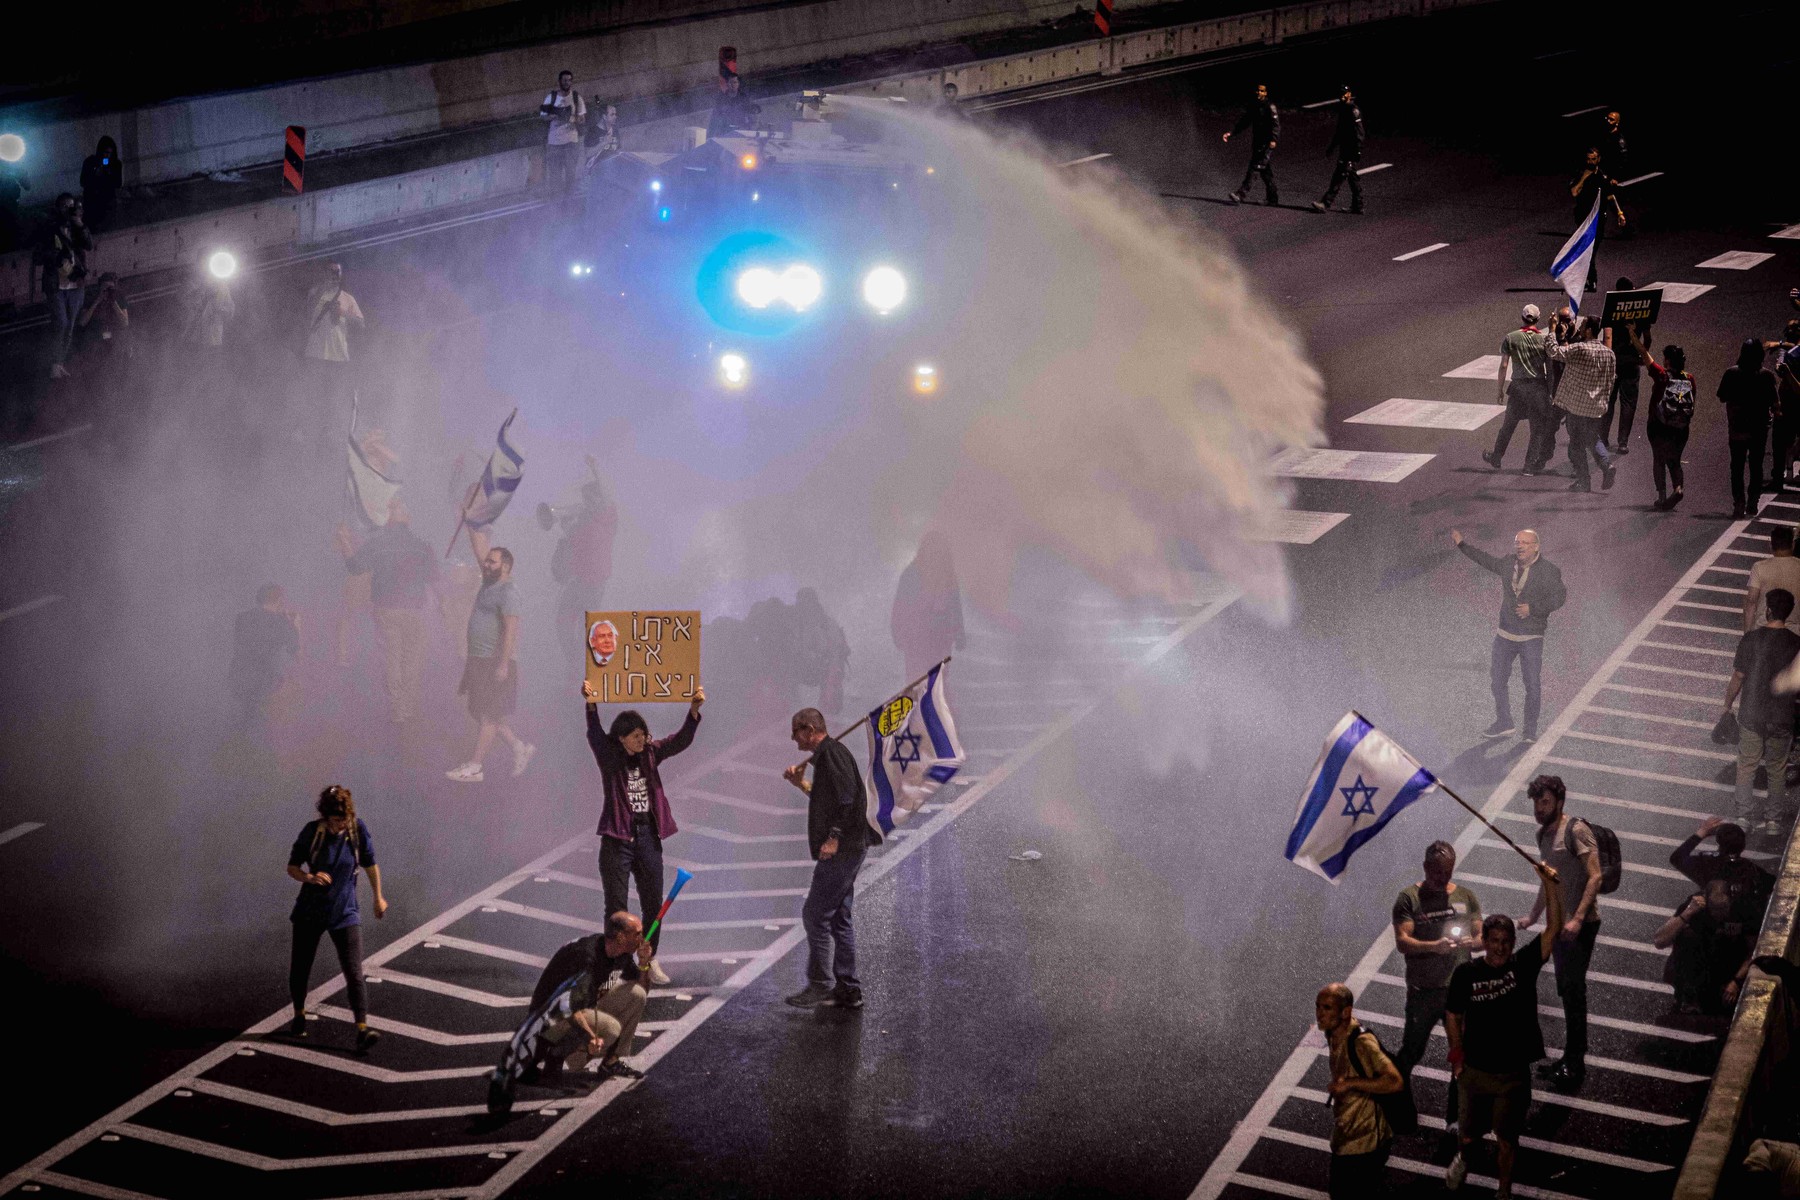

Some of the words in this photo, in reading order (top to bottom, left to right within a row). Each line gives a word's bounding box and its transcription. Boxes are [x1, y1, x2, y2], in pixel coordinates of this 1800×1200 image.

[1612, 310, 1651, 321] עכשיו!
[1616, 299, 1651, 312] עסקה
[624, 643, 662, 670] אין
[592, 672, 695, 703] ניצחון.
